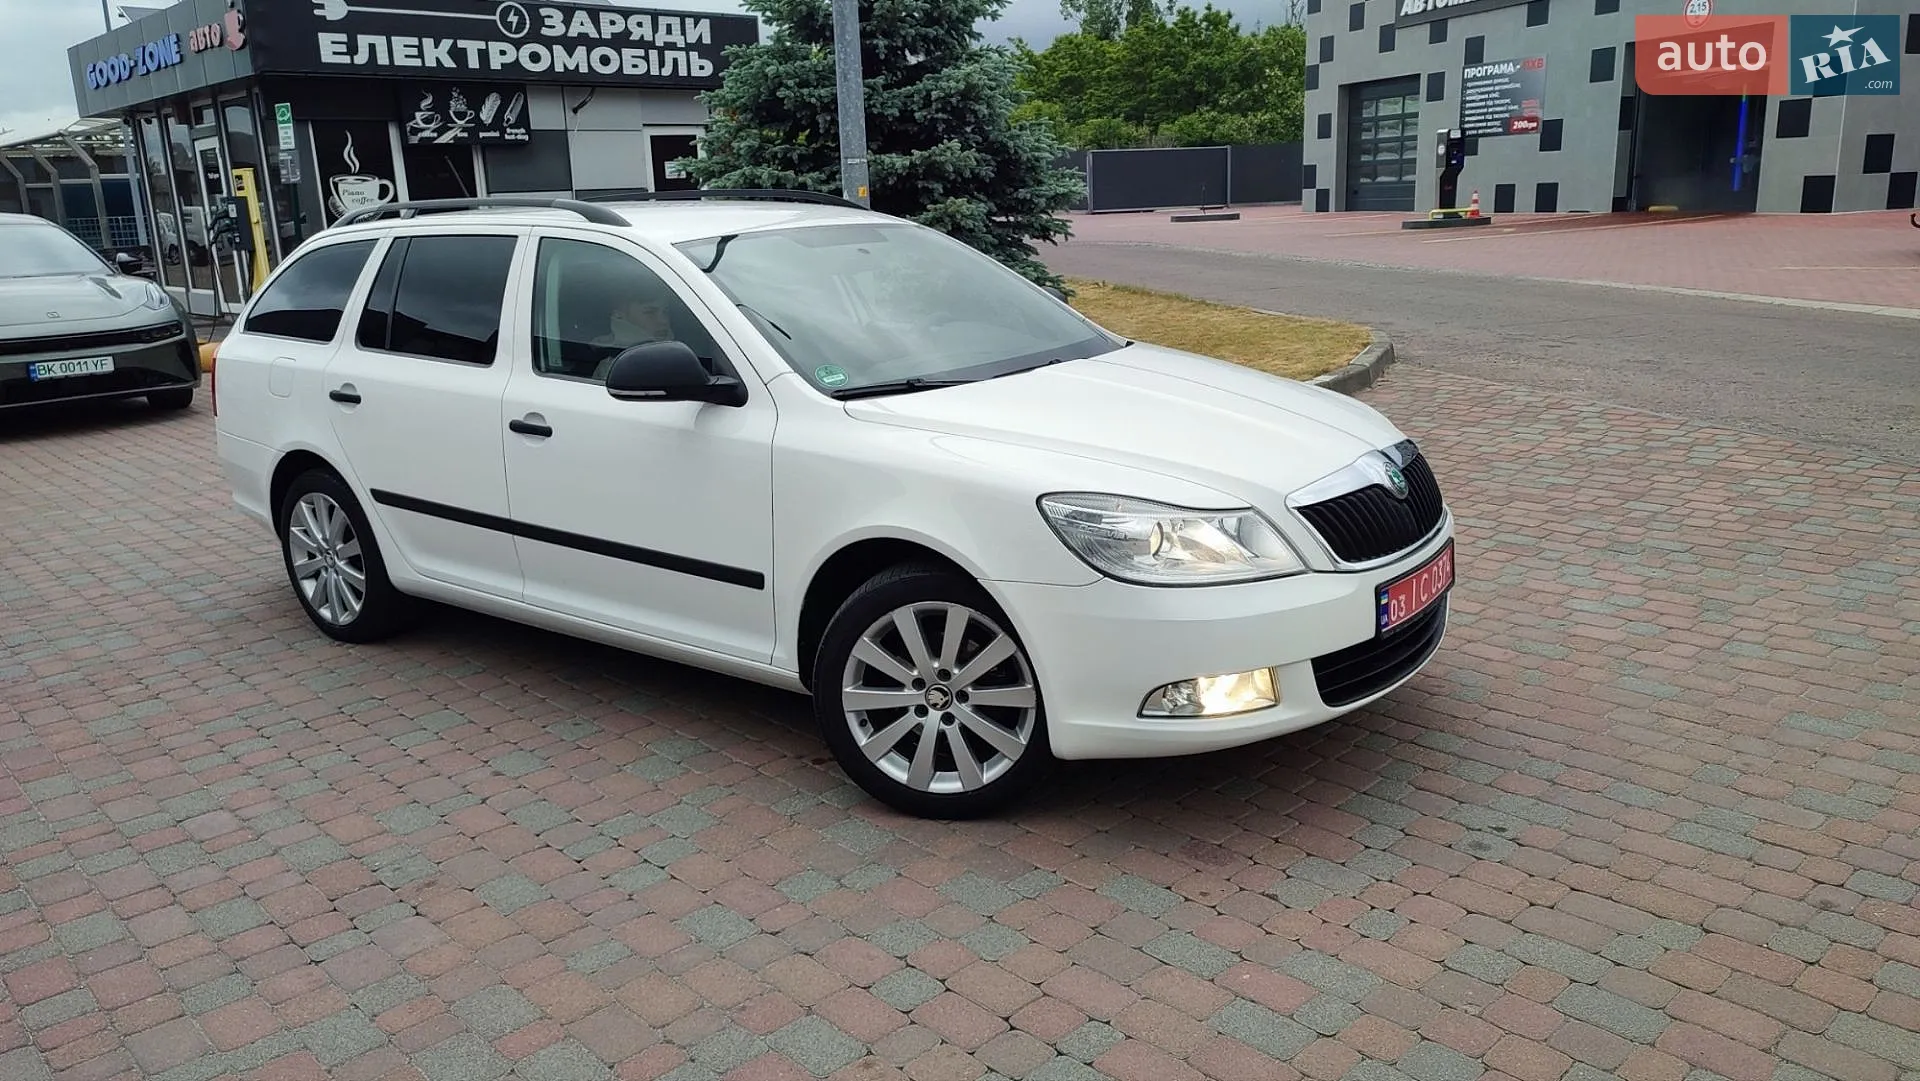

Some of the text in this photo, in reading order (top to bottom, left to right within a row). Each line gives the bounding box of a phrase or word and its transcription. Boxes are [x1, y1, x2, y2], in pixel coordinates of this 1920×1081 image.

[539, 7, 711, 48] ЗАРЯДИ
[86, 33, 182, 90] GOOD-ZONE
[317, 32, 713, 77] ЕЛЕКТРОМОБІЛЬ
[1464, 61, 1515, 79] ПРОГРАМА
[36, 363, 57, 376] BK
[60, 361, 89, 373] 0011
[91, 358, 109, 371] YF
[1390, 593, 1406, 622] 03
